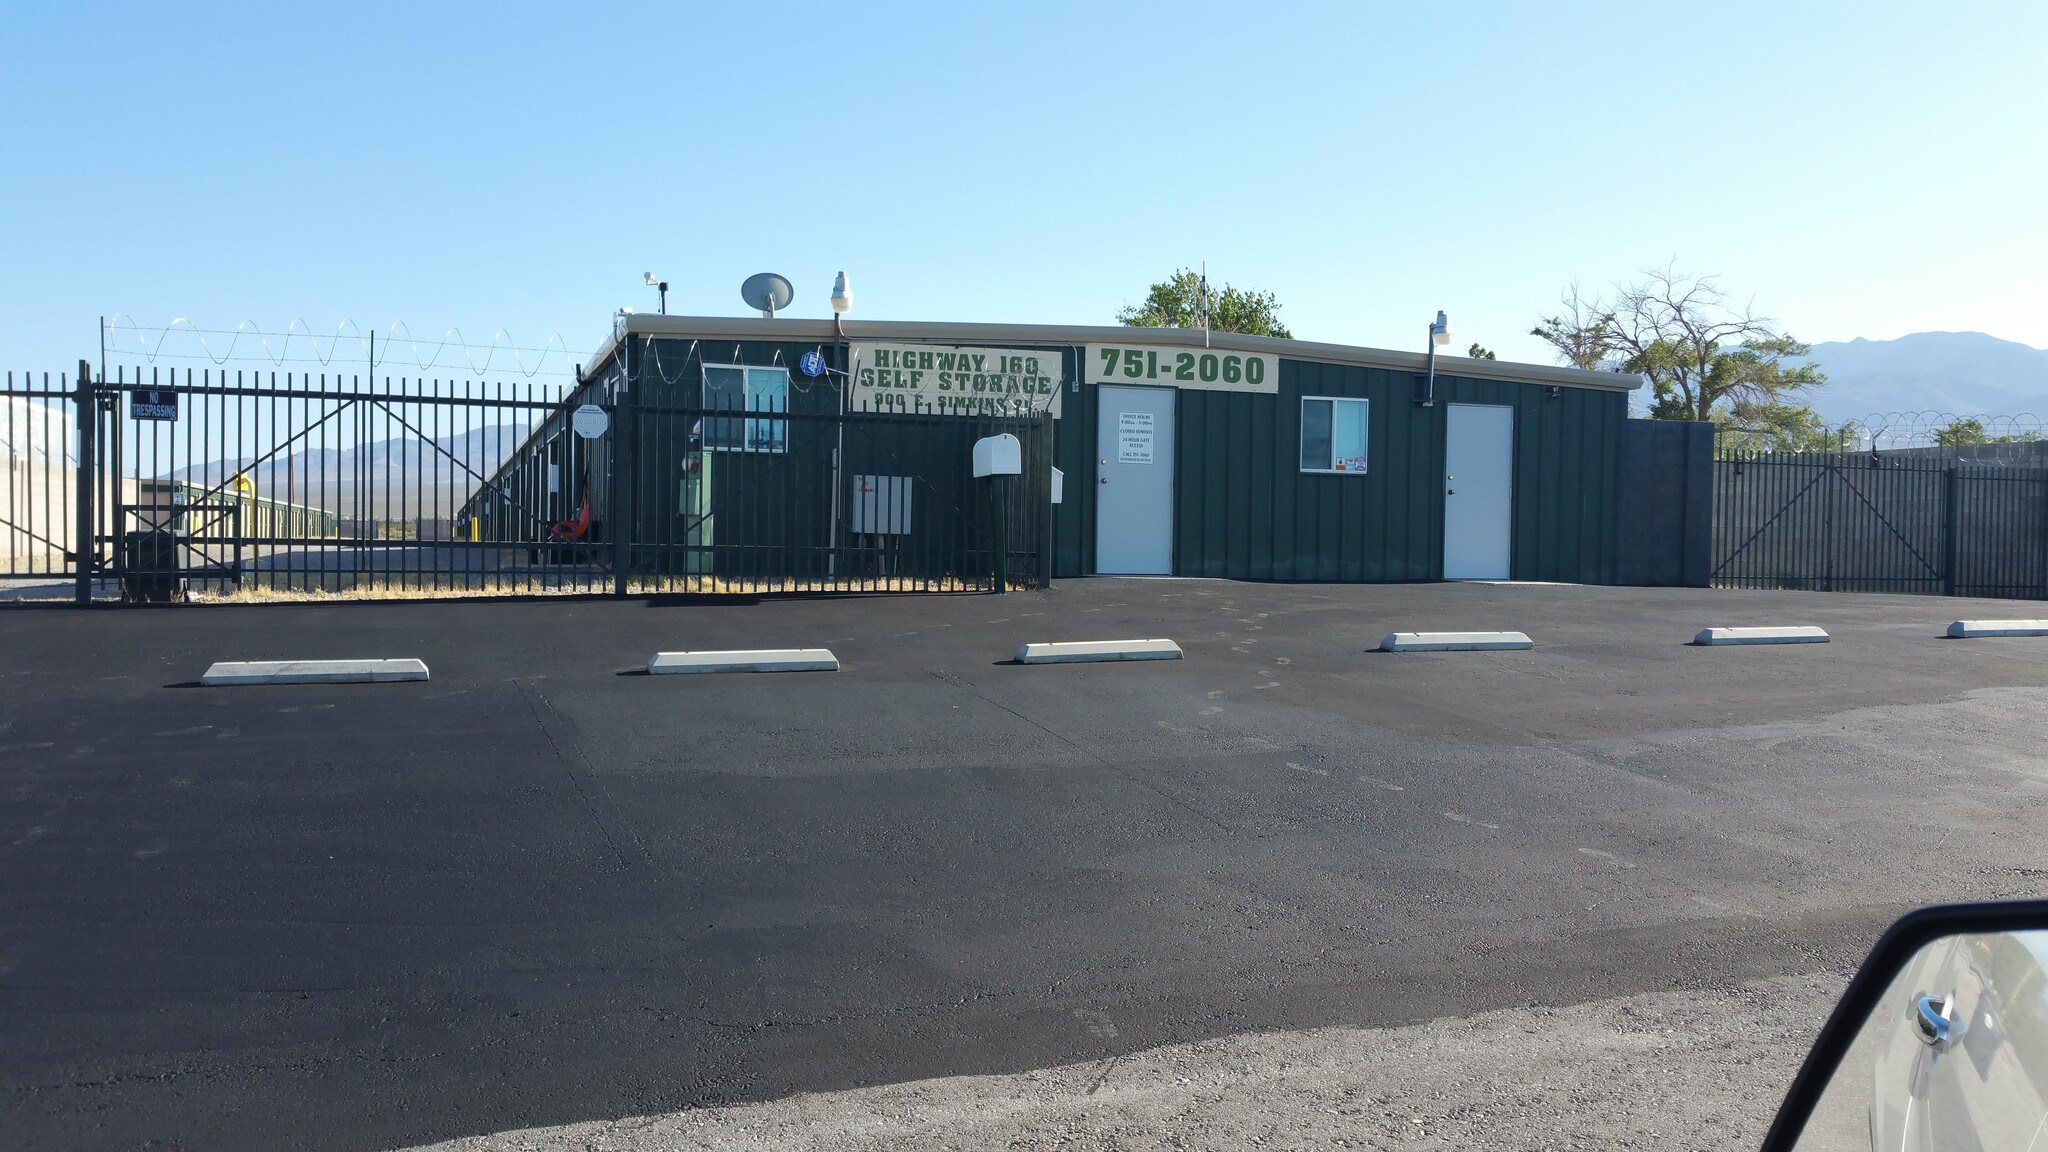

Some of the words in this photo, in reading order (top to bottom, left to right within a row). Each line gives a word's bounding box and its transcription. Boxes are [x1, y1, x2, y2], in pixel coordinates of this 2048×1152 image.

[808, 353, 819, 374] ADT
[874, 349, 986, 373] HIGHWAY
[1101, 348, 1265, 385] 751-2060
[860, 368, 924, 389] SELF
[938, 372, 1052, 395] STORAGE
[149, 391, 159, 404] NO
[874, 392, 905, 406] 900
[132, 404, 176, 417] TRESPASSING
